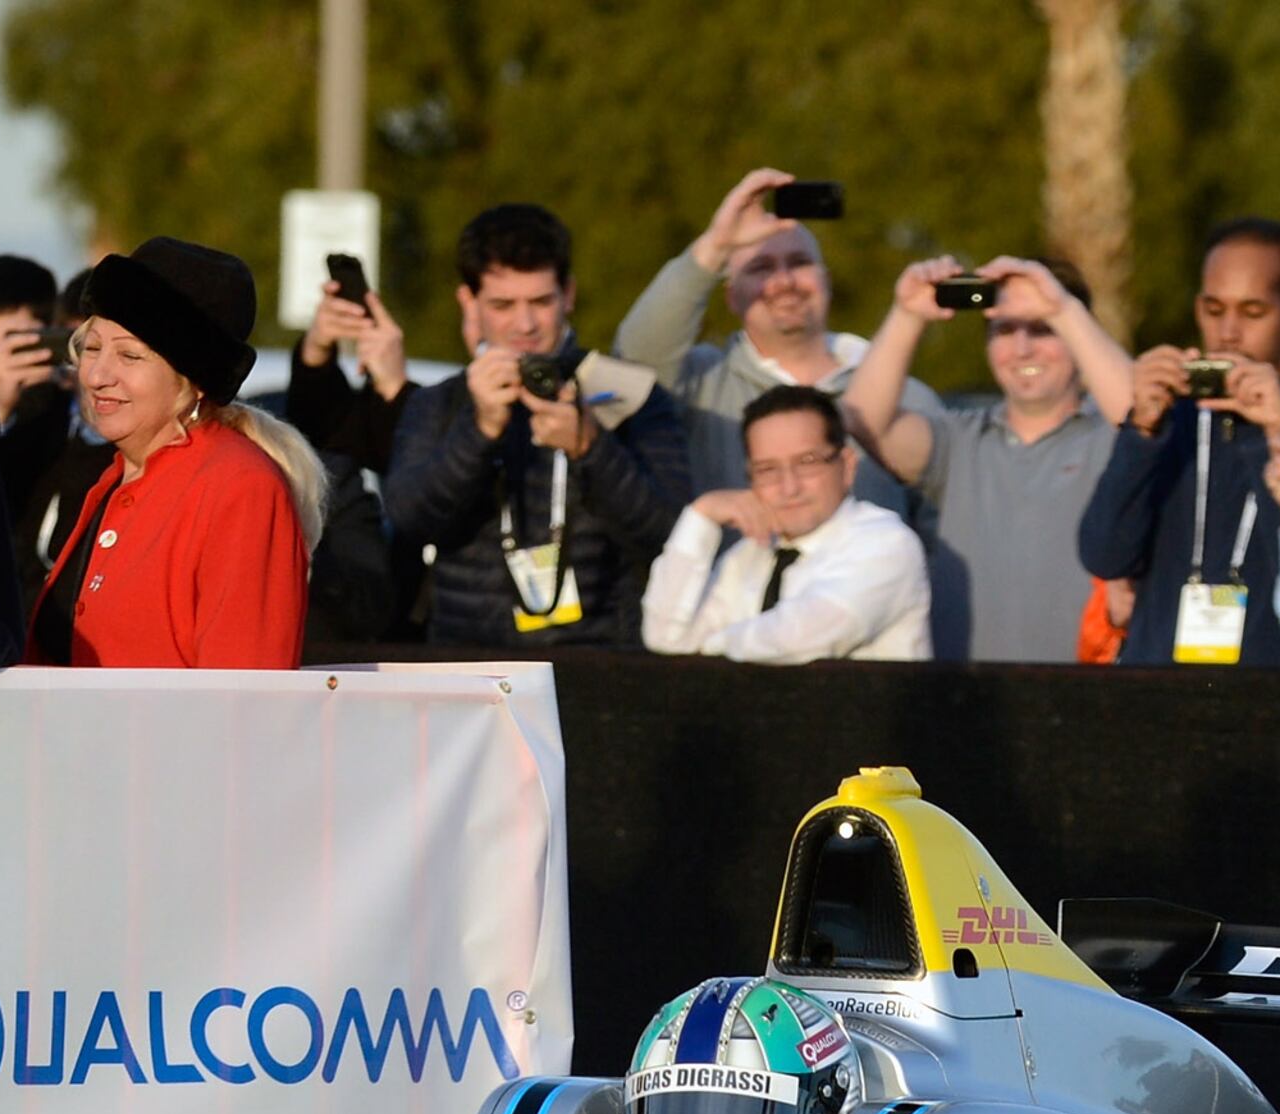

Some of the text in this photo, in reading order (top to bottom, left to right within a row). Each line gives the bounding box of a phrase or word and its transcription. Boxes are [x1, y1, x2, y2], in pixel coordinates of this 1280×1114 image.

[957, 906, 1039, 945] DHL
[802, 1029, 842, 1062] QUALCO
[631, 1068, 771, 1095] LUCAS DIGRASSI
